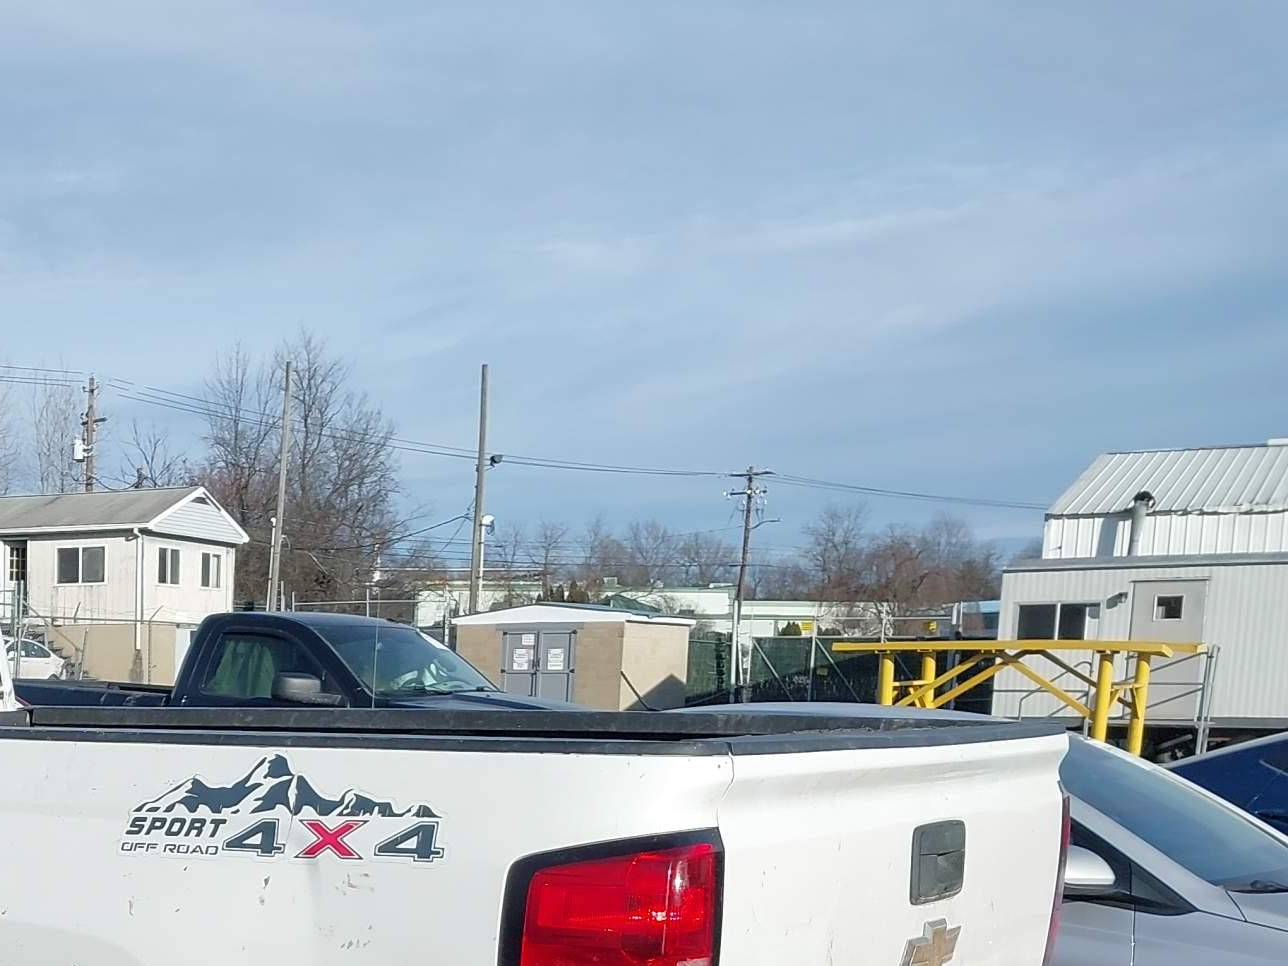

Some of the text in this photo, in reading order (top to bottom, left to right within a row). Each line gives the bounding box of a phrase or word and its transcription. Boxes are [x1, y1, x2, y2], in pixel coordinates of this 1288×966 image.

[125, 816, 228, 838] SPORT
[121, 842, 219, 855] OFF ROAD
